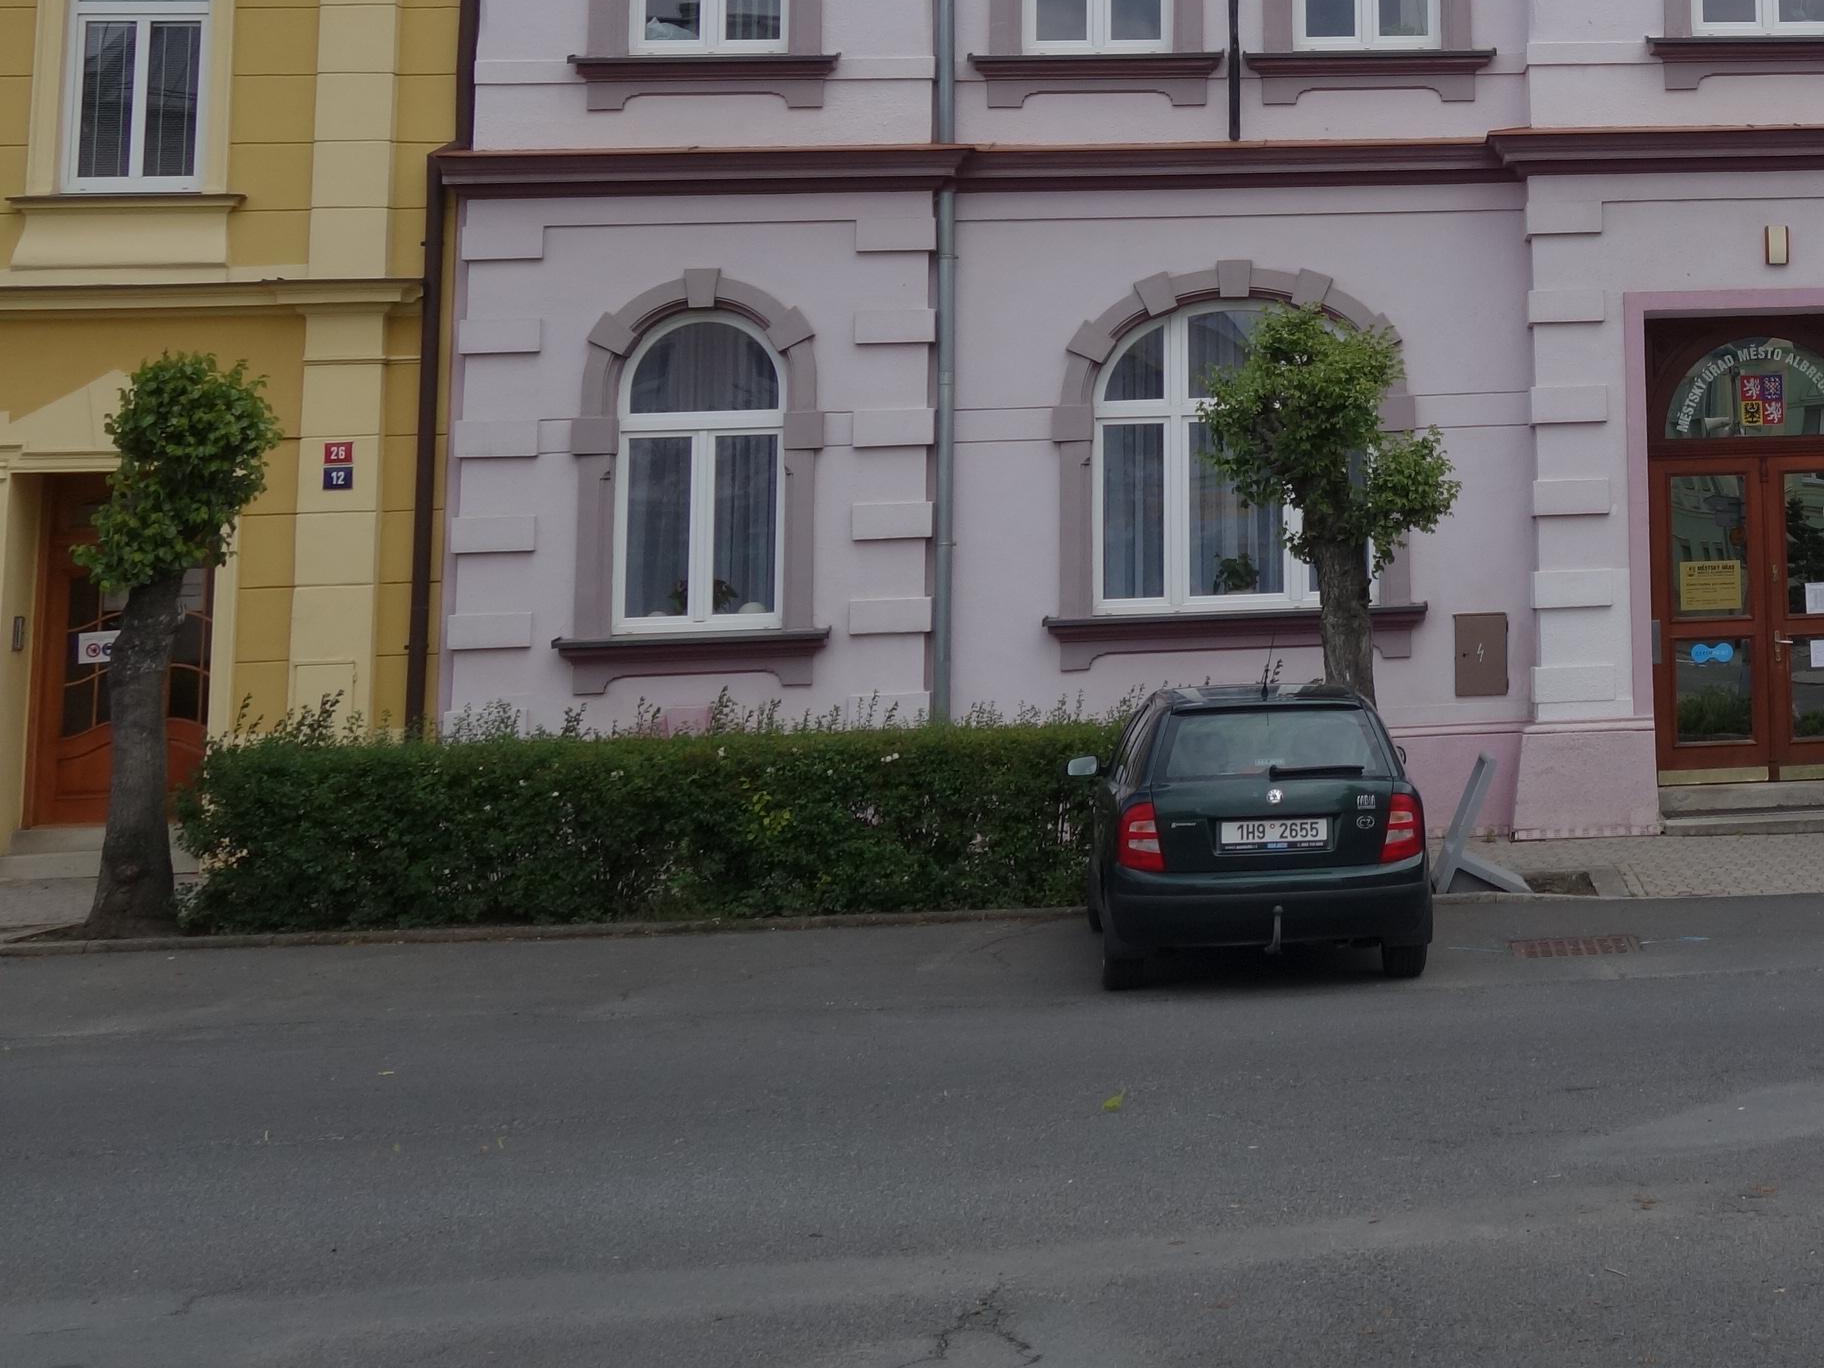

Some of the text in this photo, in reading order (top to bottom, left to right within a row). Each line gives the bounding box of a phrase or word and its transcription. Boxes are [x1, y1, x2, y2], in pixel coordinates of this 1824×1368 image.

[1676, 377, 1706, 433] MĚSTSKÝ
[1701, 354, 1735, 382] ÚŘAD
[1737, 344, 1783, 362] MĚSTO
[330, 446, 346, 460] 26
[330, 471, 345, 485] 12
[1237, 821, 1320, 841] 1H9 2655
